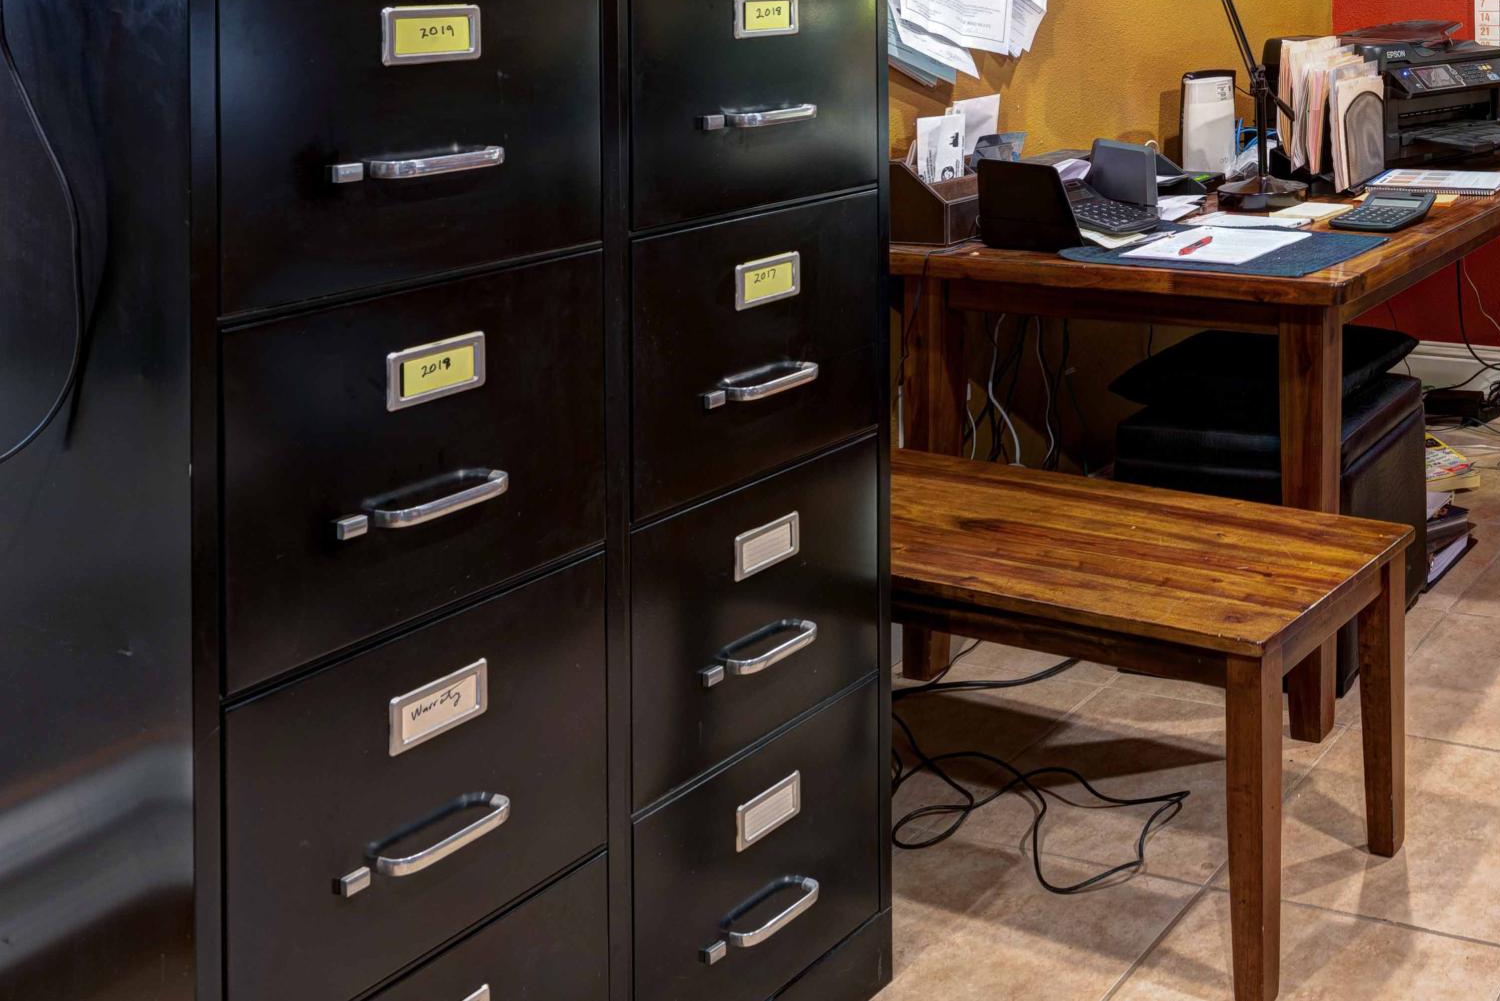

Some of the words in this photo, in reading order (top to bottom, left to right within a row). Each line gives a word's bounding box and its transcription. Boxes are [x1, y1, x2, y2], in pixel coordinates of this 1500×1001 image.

[756, 6, 782, 19] 2018
[1480, 13, 1490, 22] 14
[420, 25, 454, 39] 2019
[1480, 27, 1490, 36] 21
[1386, 50, 1406, 59] EPSON
[754, 268, 777, 284] 2017
